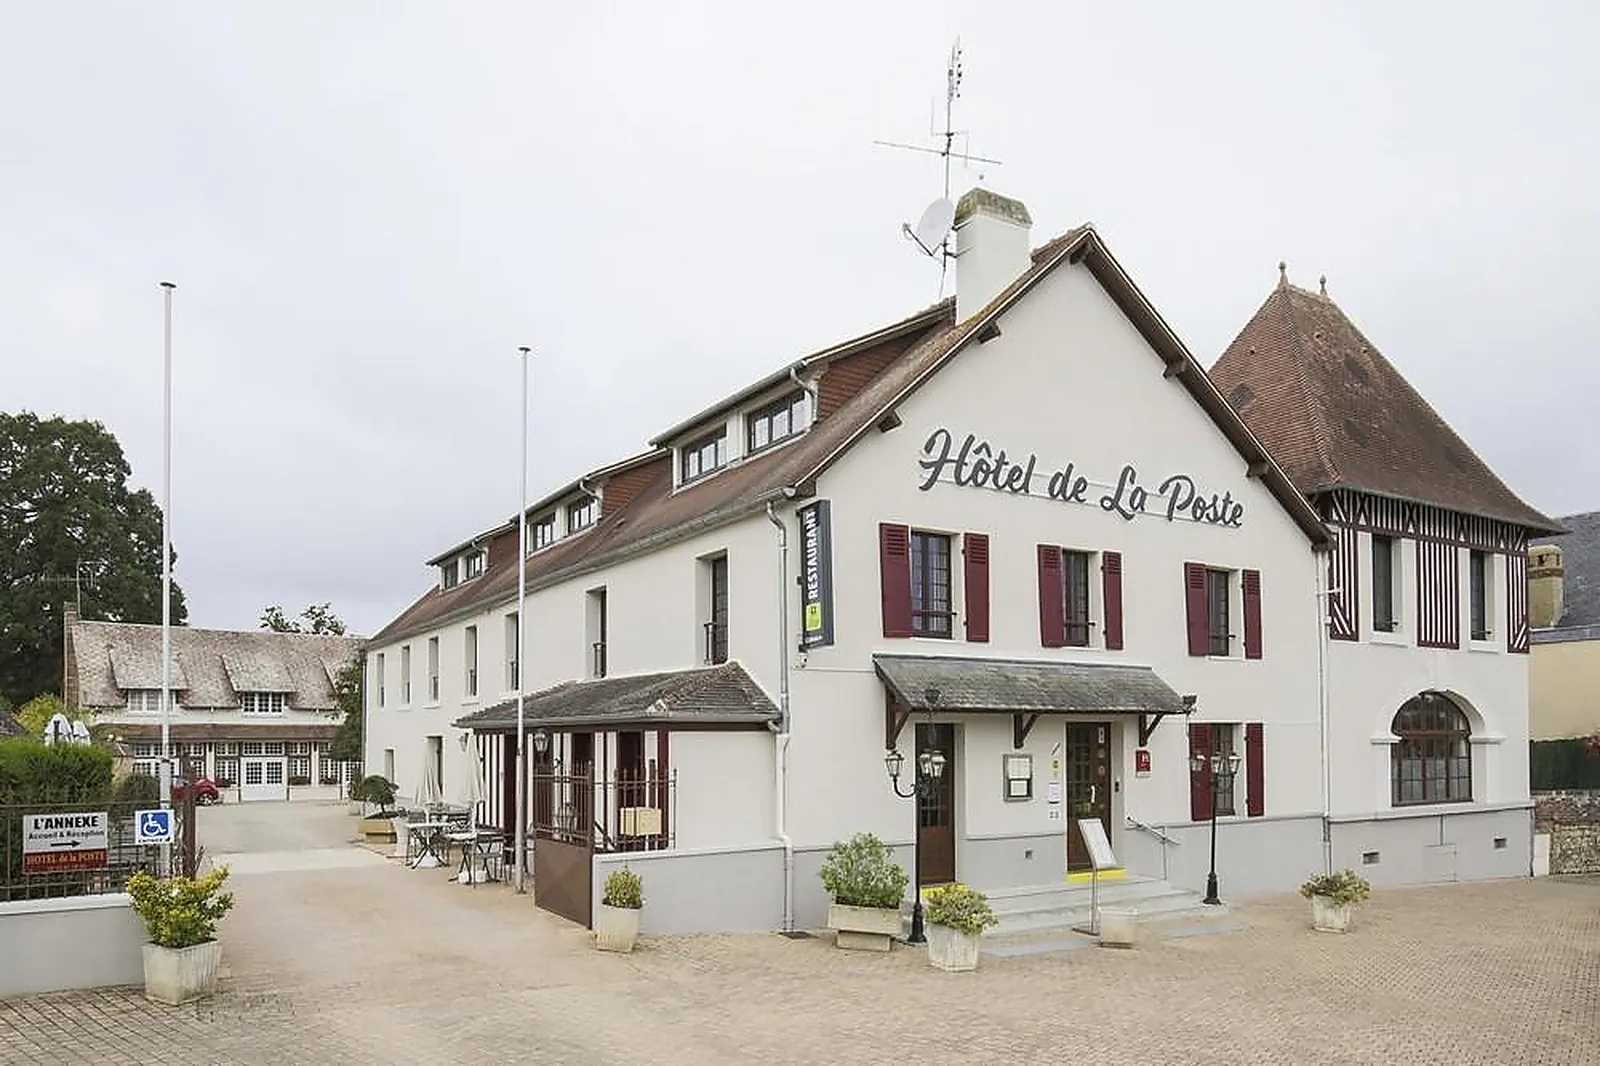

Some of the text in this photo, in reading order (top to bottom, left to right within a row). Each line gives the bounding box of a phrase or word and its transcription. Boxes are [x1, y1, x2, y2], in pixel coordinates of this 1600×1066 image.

[919, 428, 1244, 527] Hôtel de La Poste
[805, 509, 819, 600] RESTAURANT
[34, 816, 99, 830] L'ANNEXE
